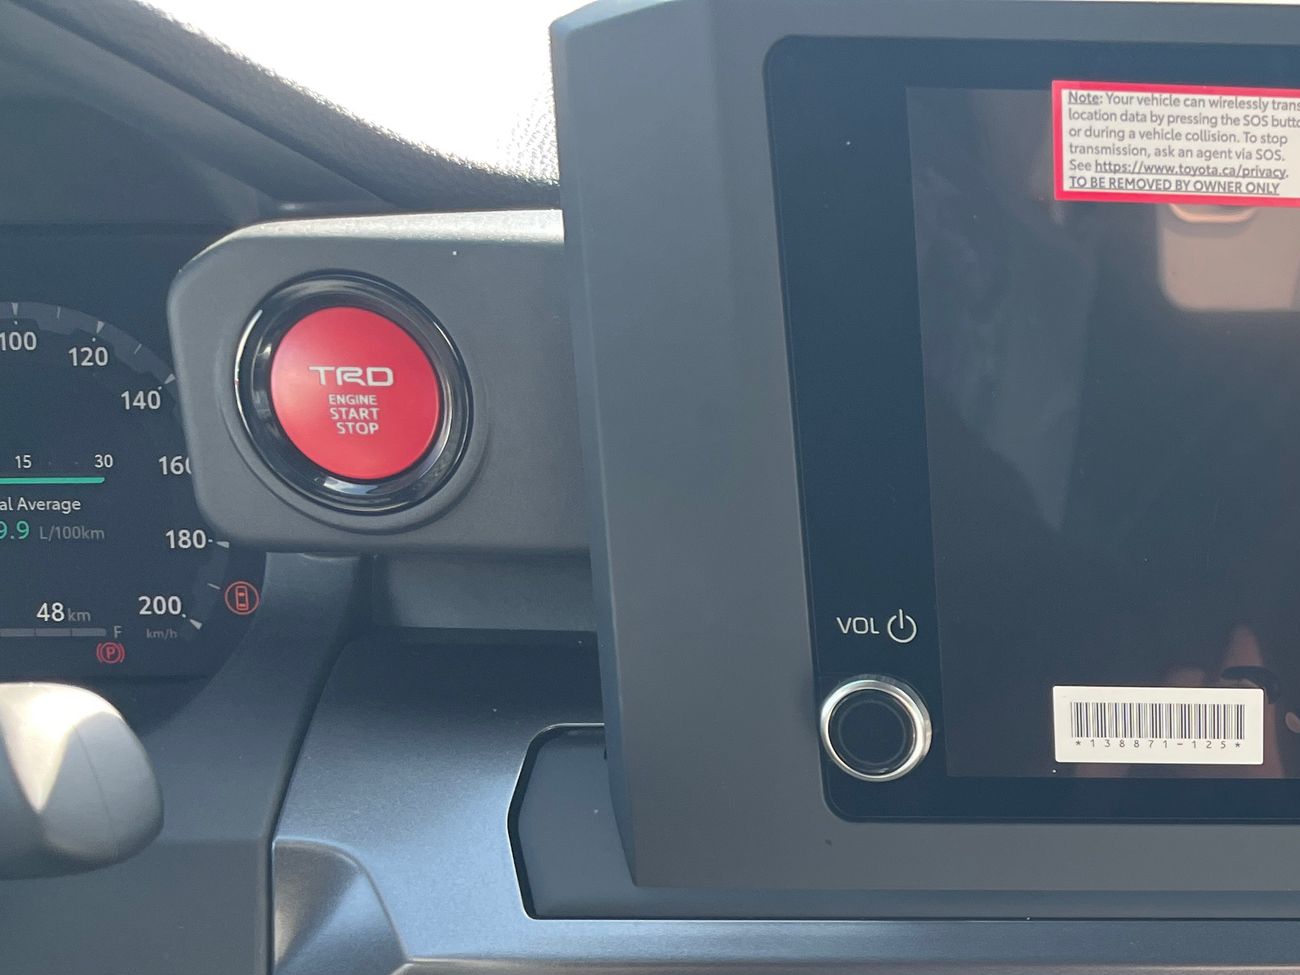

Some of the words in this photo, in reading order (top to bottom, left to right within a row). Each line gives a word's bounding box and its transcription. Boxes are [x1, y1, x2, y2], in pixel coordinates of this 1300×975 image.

[1068, 91, 1103, 105] Note:
[1105, 92, 1134, 105] Your
[1137, 94, 1181, 107] vehicle
[1183, 97, 1205, 108] can
[1208, 96, 1269, 113] wirelessly
[1068, 108, 1117, 121] location
[1120, 110, 1147, 122] data
[1150, 111, 1164, 126] by
[1167, 112, 1218, 128] pressing
[1221, 113, 1240, 126] the
[1243, 115, 1268, 127] SOS
[1069, 128, 1081, 137] or
[1084, 126, 1125, 141] during
[1129, 130, 1136, 139] a
[1139, 128, 1182, 140] vehicle
[1185, 129, 1240, 143] collision.
[1243, 131, 1257, 144] To
[1260, 132, 1288, 147] stop
[1069, 143, 1151, 158] transmission,
[1154, 145, 1175, 157] ask
[1178, 148, 1193, 158] an
[1196, 149, 1232, 161] agent
[1235, 148, 1252, 160] via
[1255, 149, 1285, 161] SOS.
[1069, 160, 1092, 171] See
[1095, 160, 1288, 180] https://www.toyota.ca/privacy.
[1069, 176, 1087, 189] TO
[1090, 177, 1105, 189] BE
[1109, 177, 1172, 191] REMOVED
[1175, 179, 1191, 192] BY
[1193, 180, 1242, 193] OWNER
[1245, 182, 1280, 195] ONLY
[0, 331, 37, 351] 100
[68, 346, 109, 366] 120
[309, 366, 394, 386] TRD
[120, 390, 161, 410] 140
[329, 394, 377, 405] ENGINE
[330, 407, 380, 420] START
[336, 422, 379, 435] STOP
[15, 455, 32, 468] 15
[94, 454, 113, 468] 30
[17, 497, 81, 514] Average
[39, 525, 105, 541] L/100km
[165, 529, 206, 549] 180
[37, 602, 65, 622] 48
[67, 608, 91, 622] km
[138, 596, 182, 615] 200
[114, 625, 122, 638] F
[146, 628, 178, 639] km/h
[836, 617, 880, 634] VOL
